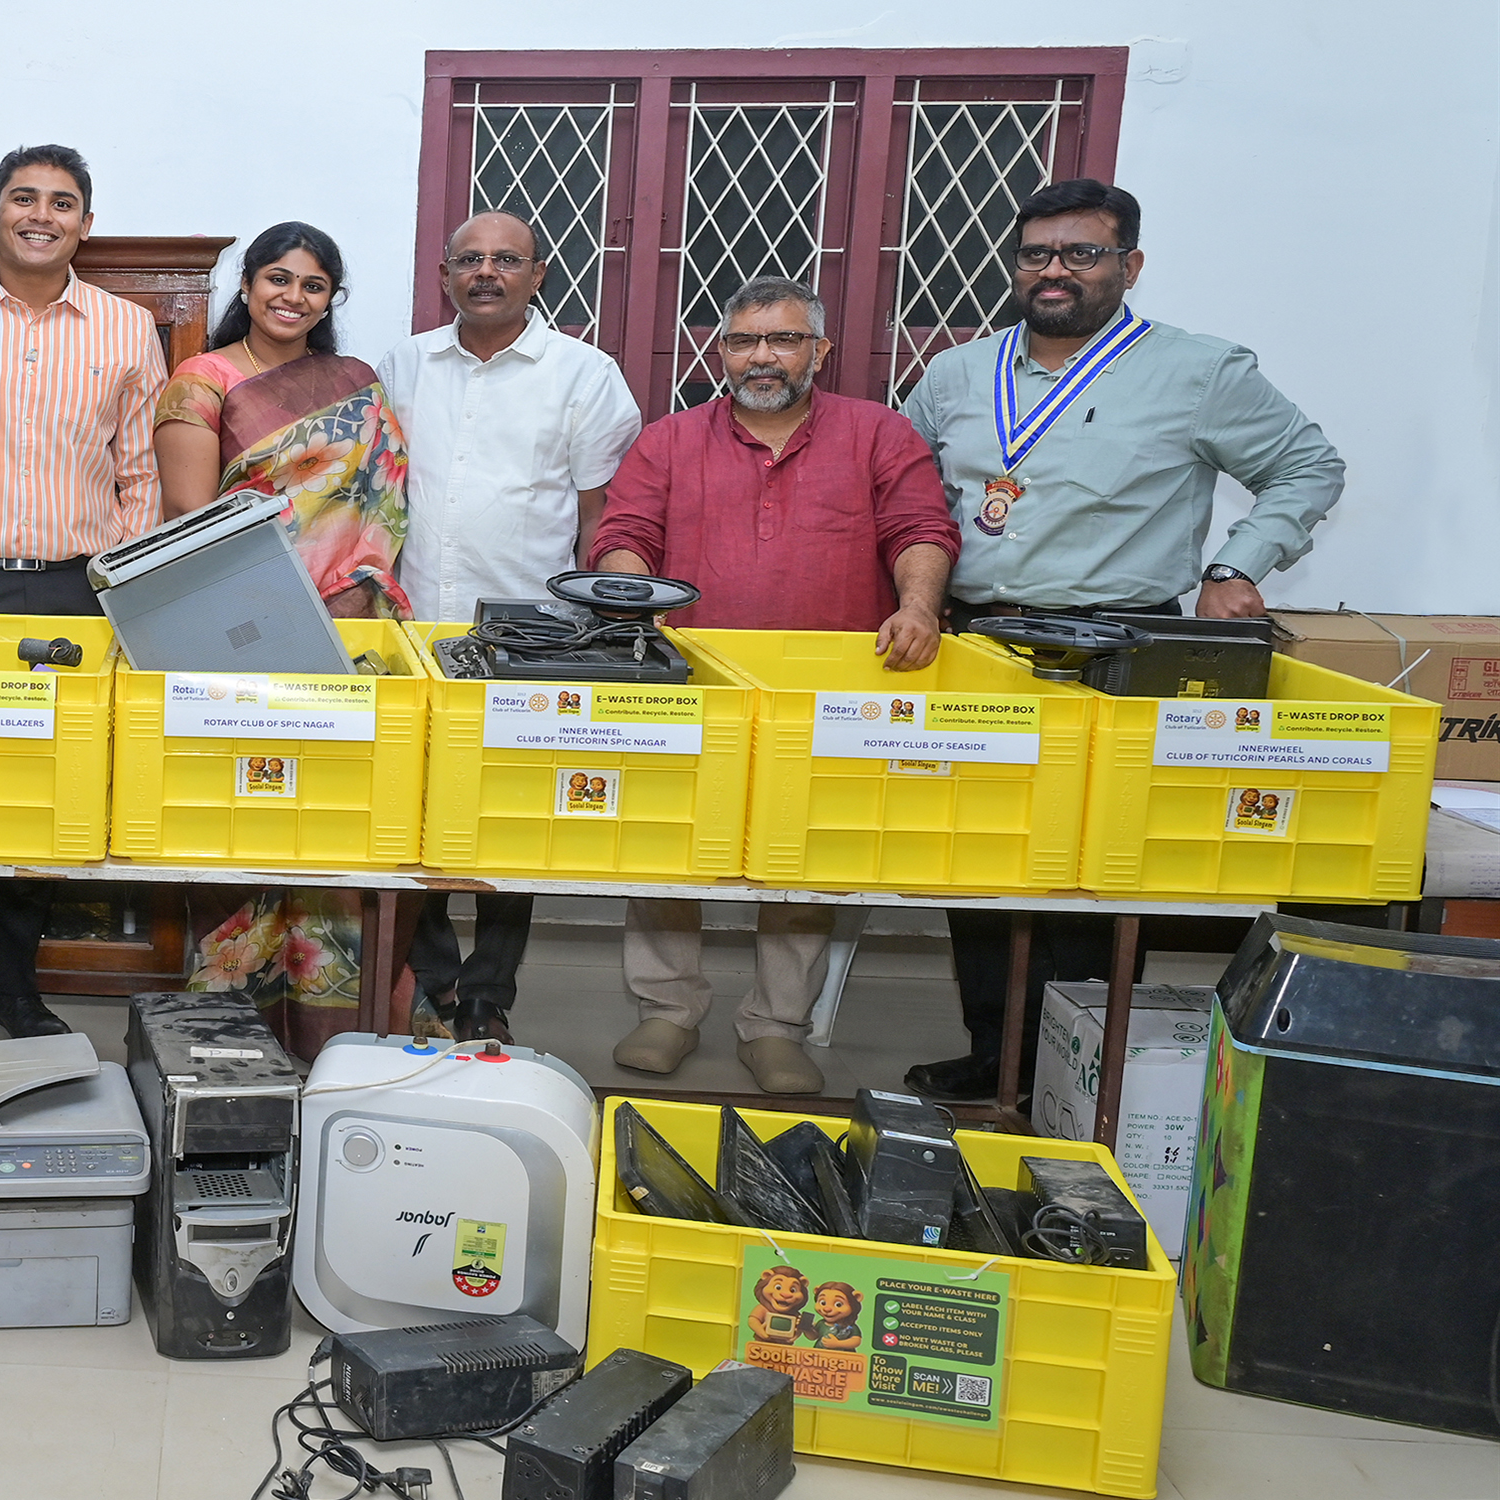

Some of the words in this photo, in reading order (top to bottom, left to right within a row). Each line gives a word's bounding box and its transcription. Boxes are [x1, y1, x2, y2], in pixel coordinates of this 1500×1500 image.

[172, 685, 205, 696] Rotary
[492, 696, 526, 708] Rotary
[823, 704, 857, 715] Rotary
[931, 704, 979, 712] E-WASTE
[1166, 714, 1202, 724] Rotary
[1278, 712, 1327, 720] E-WASTE
[558, 736, 608, 745] TUTICORIN
[1238, 745, 1304, 753] INNERWHEEL
[1212, 754, 1264, 762] TUTICORIN
[1268, 755, 1305, 763] PEARLS
[1332, 757, 1372, 765] CORALS
[1254, 820, 1273, 828] Singam
[1076, 1063, 1097, 1096] AC
[880, 1280, 906, 1289] PLACE
[908, 1284, 932, 1292] YOUR
[934, 1287, 972, 1298] E-WASTE
[975, 1292, 997, 1301] HERE
[954, 1315, 976, 1323] CLASS
[900, 1322, 937, 1331] ACCEPTED
[930, 1338, 955, 1347] WASTE
[899, 1341, 929, 1349] BROKEN
[930, 1345, 955, 1354] GLASS,
[957, 1349, 983, 1358] PLEASE
[749, 1346, 800, 1365] Soolal
[803, 1352, 862, 1372] Singam
[873, 1356, 886, 1364] To
[873, 1364, 903, 1375] Know
[872, 1373, 901, 1383] More
[914, 1372, 940, 1382] SCAN
[794, 1382, 842, 1398] LLENGE
[872, 1380, 896, 1391] Visit
[912, 1380, 939, 1394] ME!
